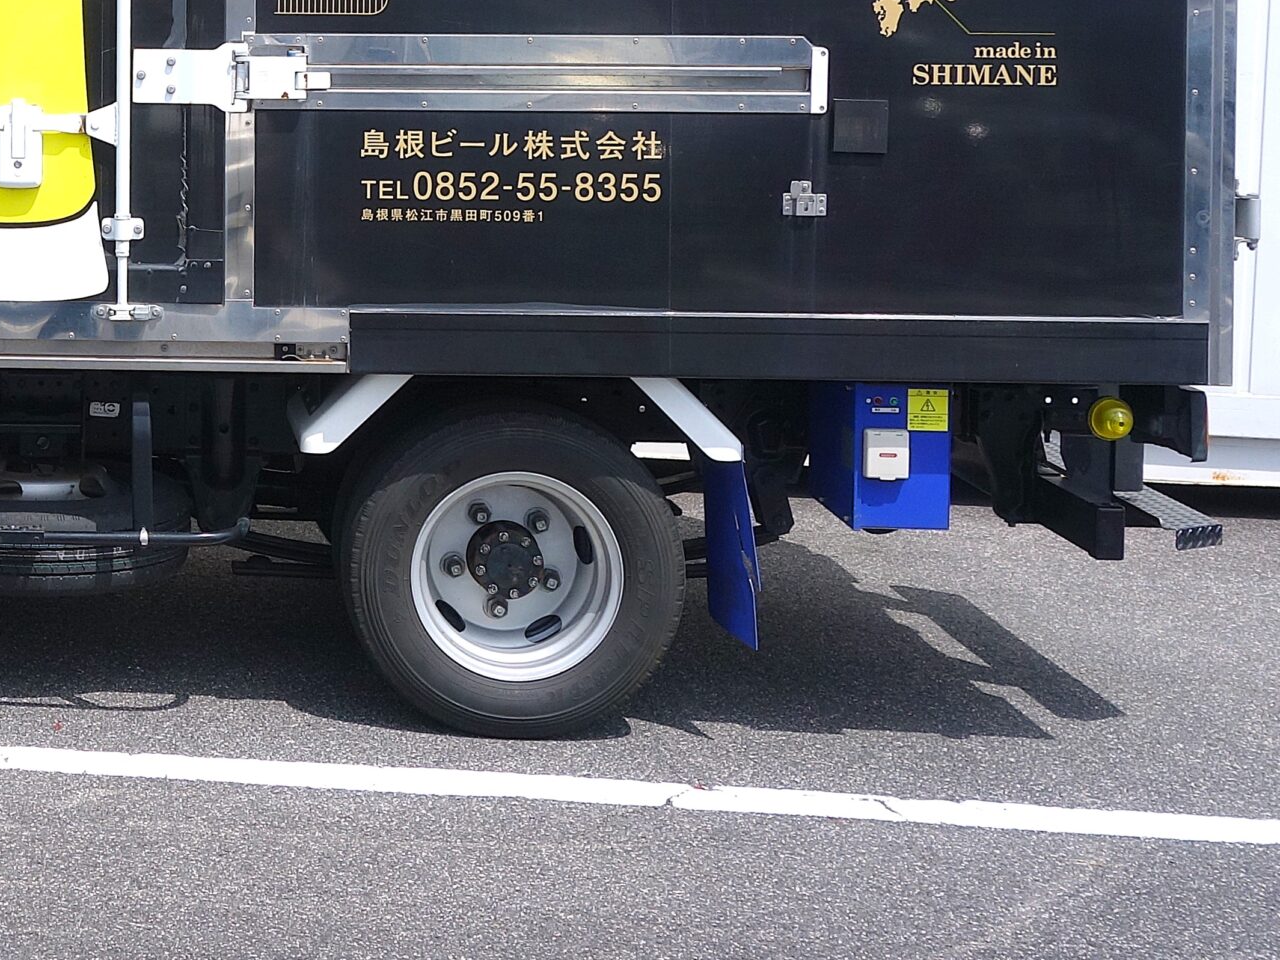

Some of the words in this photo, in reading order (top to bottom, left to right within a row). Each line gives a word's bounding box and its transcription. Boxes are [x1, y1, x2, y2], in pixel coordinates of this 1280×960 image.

[974, 41, 1032, 59] made
[1034, 41, 1057, 59] in
[912, 64, 1058, 86] SHIMANE
[360, 129, 663, 161] 島根ビール株式会社
[412, 171, 661, 202] 0852-55-8355
[361, 208, 543, 224] 島根県松江市黒田町509番1
